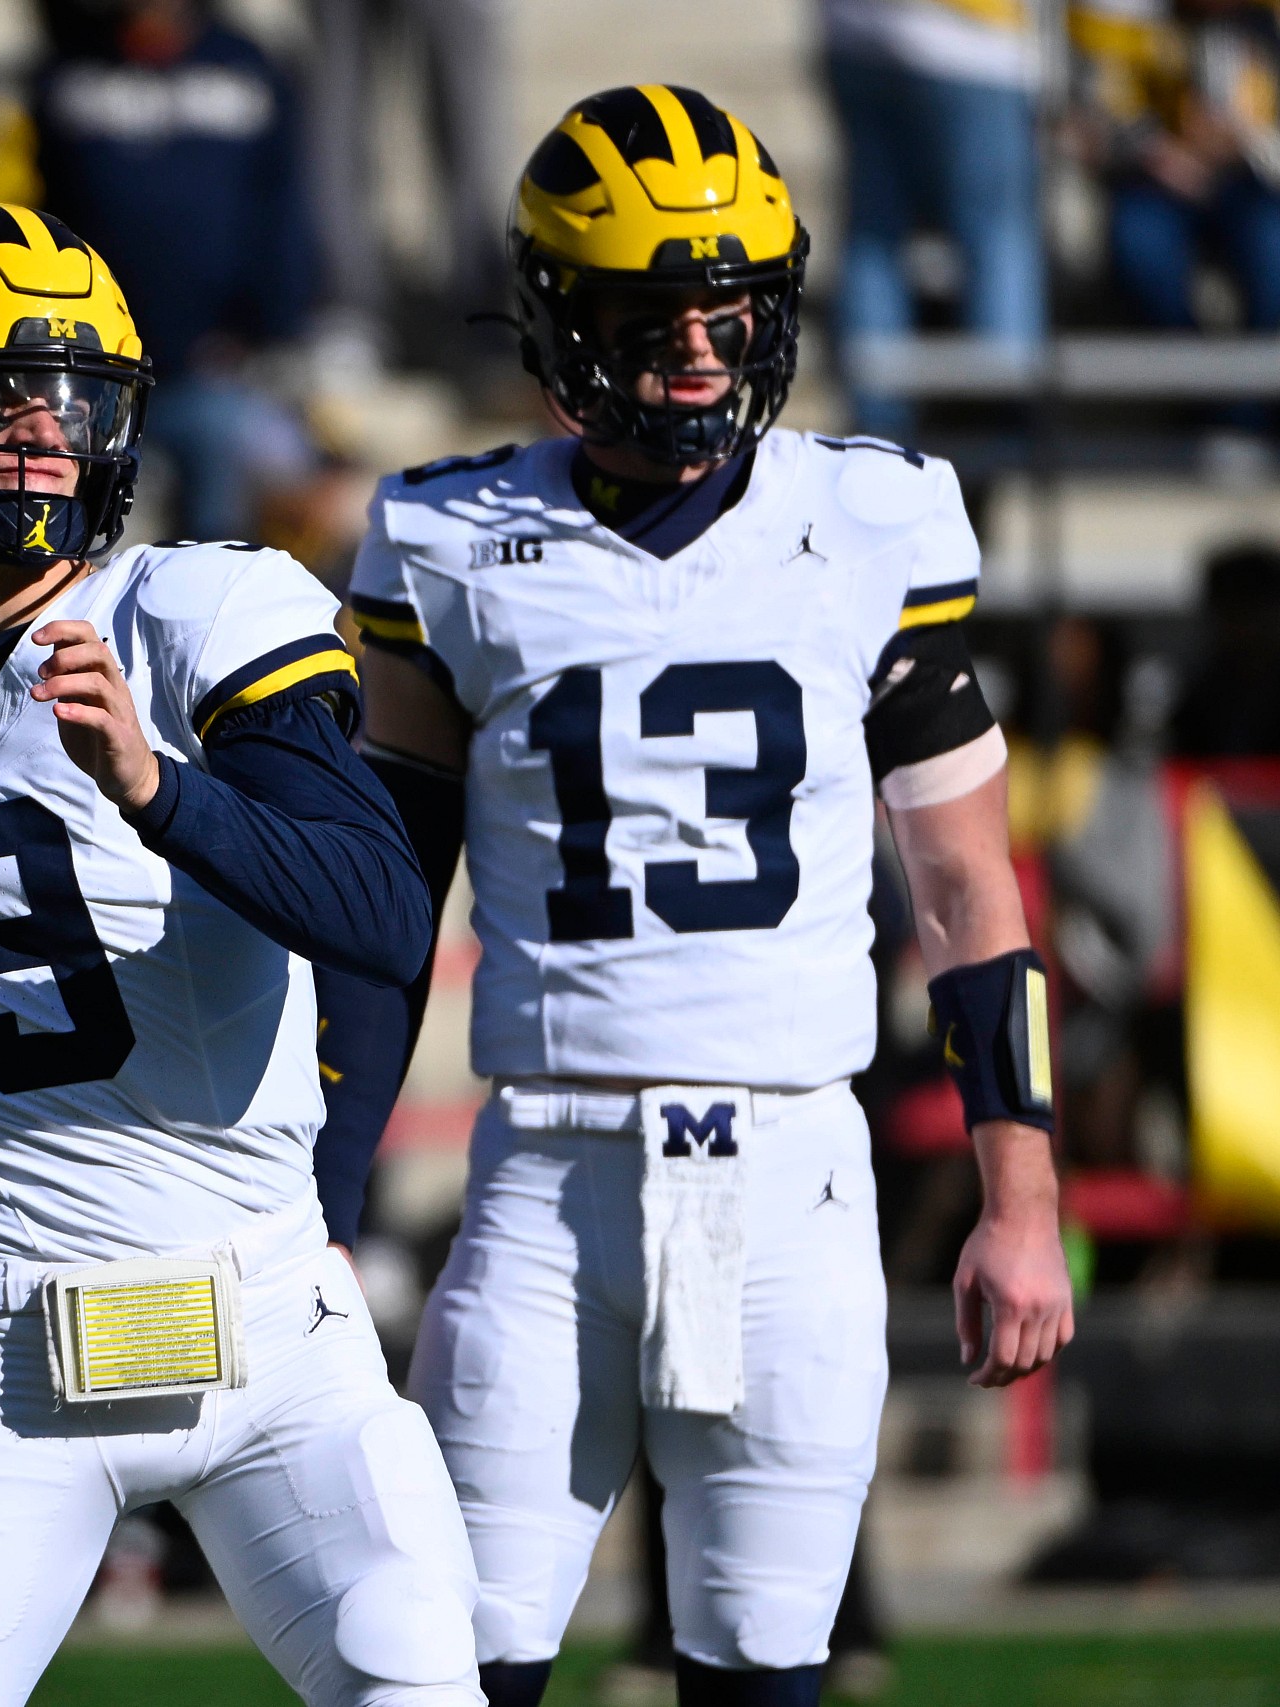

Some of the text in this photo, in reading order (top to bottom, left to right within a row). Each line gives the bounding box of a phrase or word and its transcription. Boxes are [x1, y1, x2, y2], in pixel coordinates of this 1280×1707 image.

[689, 236, 719, 259] M
[47, 318, 77, 339] M
[528, 660, 807, 942] 13
[660, 1102, 738, 1158] M
